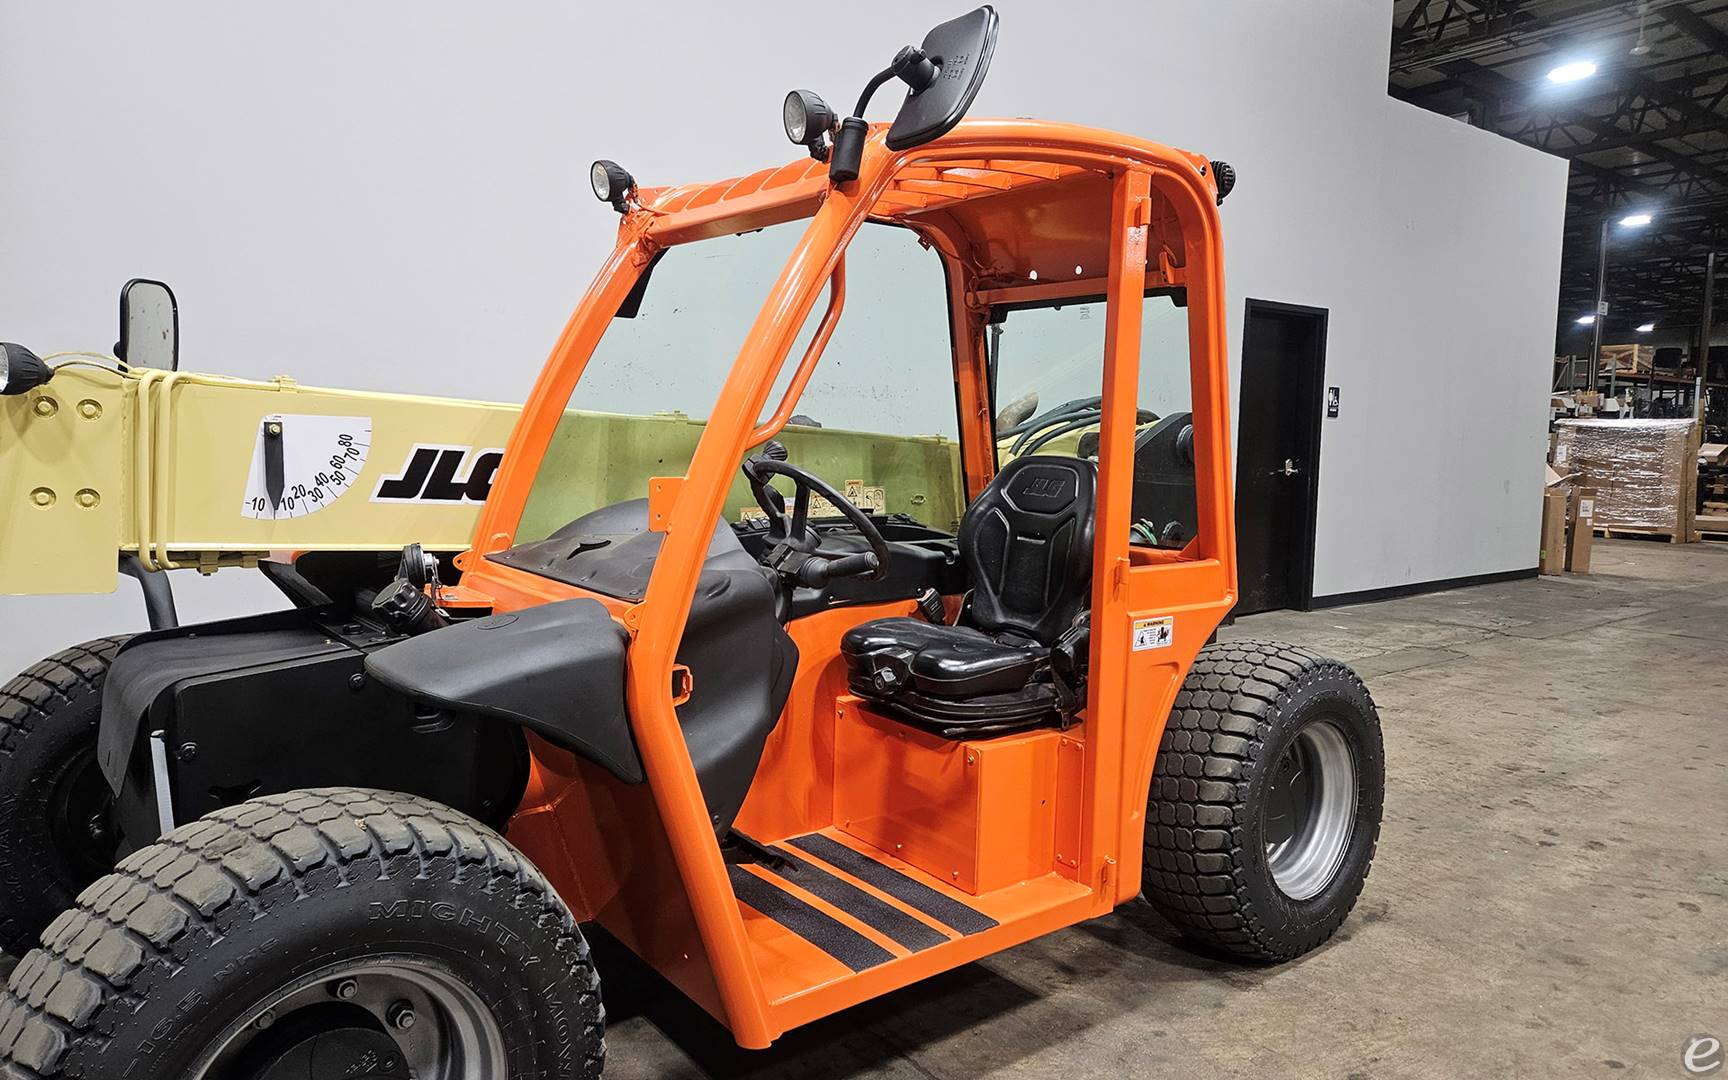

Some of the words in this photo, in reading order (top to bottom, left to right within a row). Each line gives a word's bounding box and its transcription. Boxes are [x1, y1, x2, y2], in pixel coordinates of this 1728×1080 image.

[338, 434, 353, 447] 80
[343, 447, 360, 461] 70
[329, 455, 346, 470] 60
[314, 472, 330, 487] 40
[329, 470, 346, 485] 50
[291, 484, 307, 500] 20
[307, 487, 324, 503] 30
[280, 496, 295, 511] 10
[368, 899, 541, 967] MIGHTY
